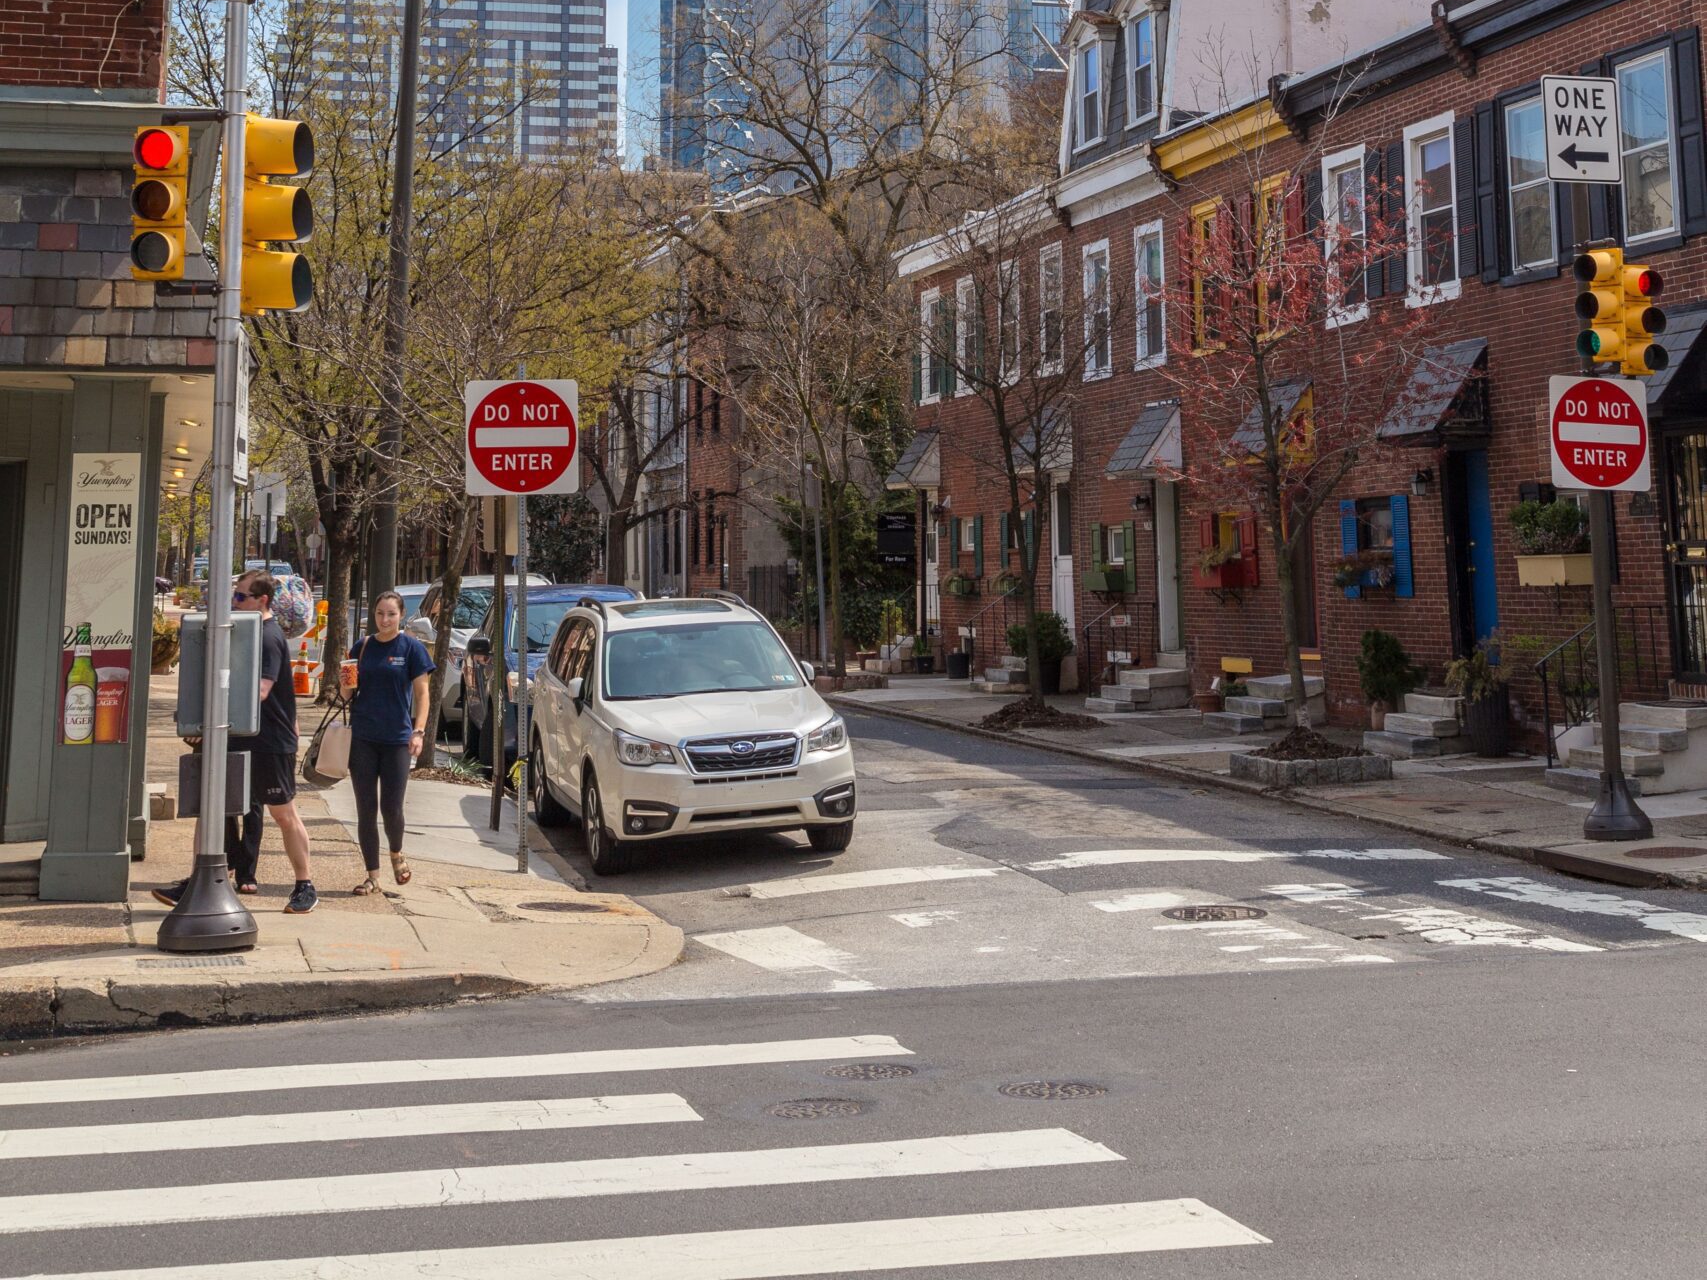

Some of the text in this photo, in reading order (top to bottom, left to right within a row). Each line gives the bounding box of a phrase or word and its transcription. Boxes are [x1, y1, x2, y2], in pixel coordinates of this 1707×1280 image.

[1555, 86, 1606, 110] ONE
[1554, 114, 1608, 138] WAY
[484, 404, 560, 422] DO NOT
[1565, 399, 1631, 419] DO NOT
[492, 453, 553, 471] ENTER
[1573, 448, 1628, 467] ENTER
[77, 472, 136, 488] Yuengling
[75, 503, 132, 529] OPEN
[74, 530, 132, 545] SUNDAYS!
[63, 625, 133, 650] Yuenglin
[65, 716, 93, 725] LAGER
